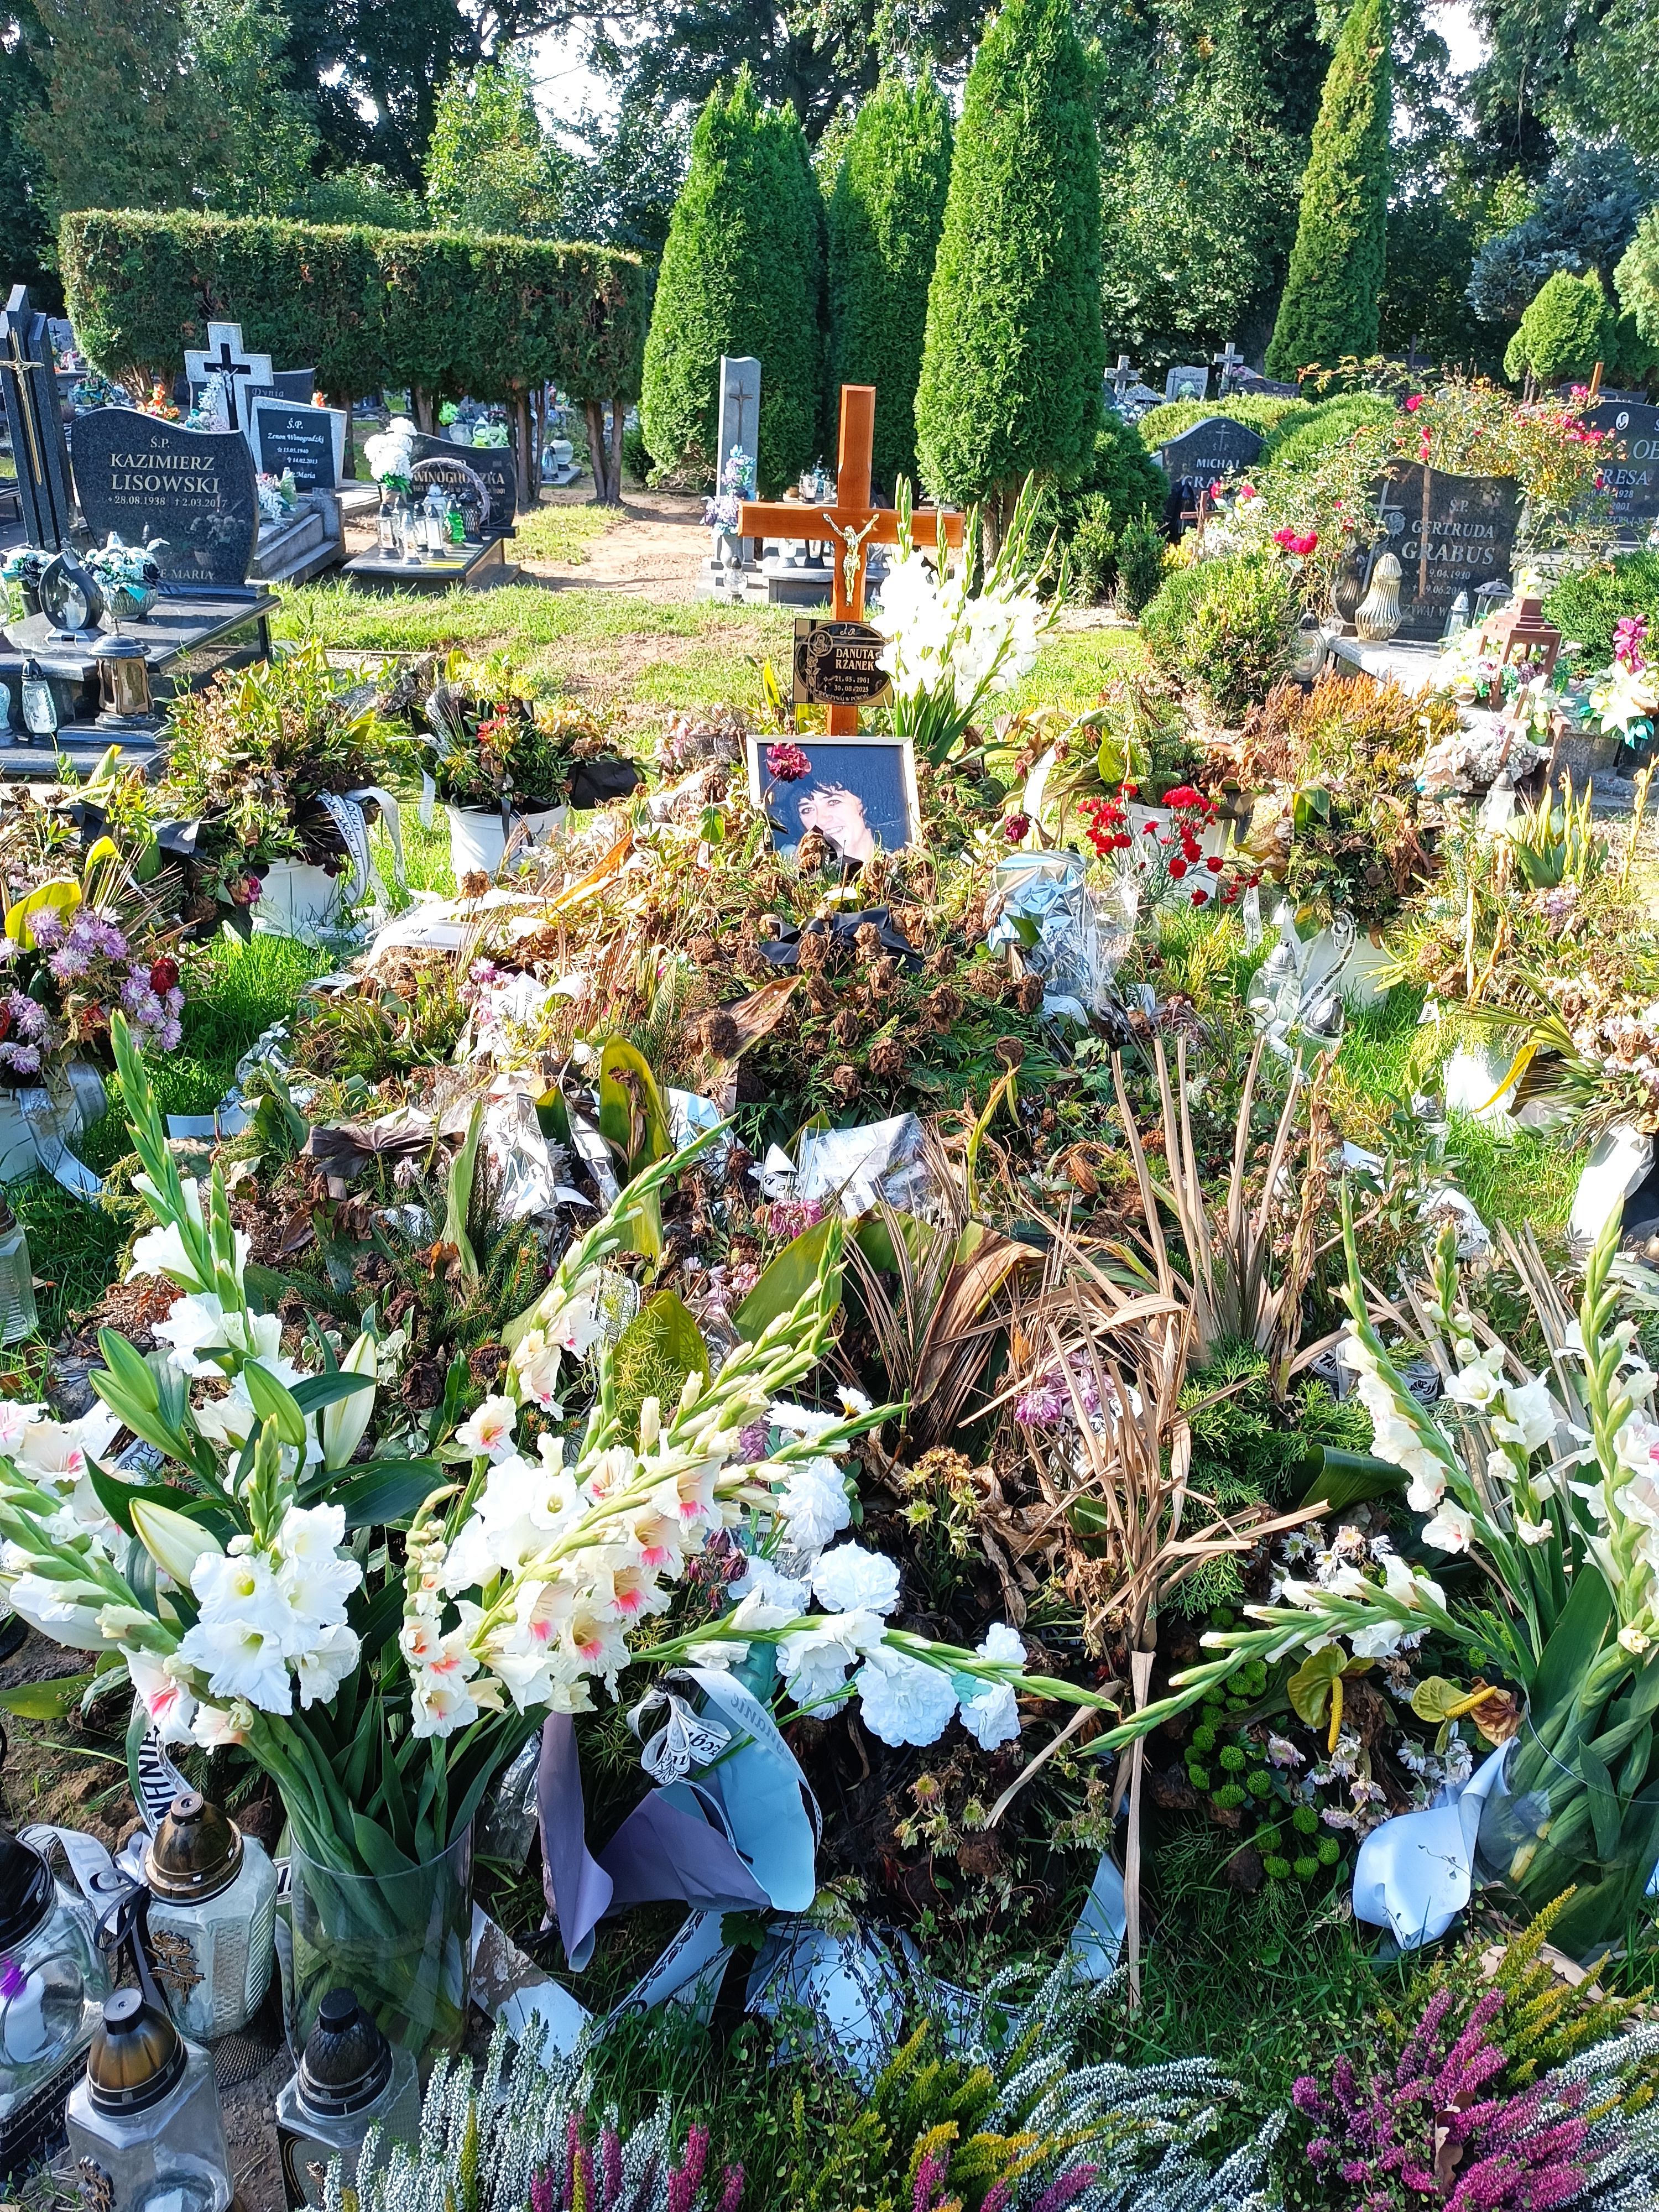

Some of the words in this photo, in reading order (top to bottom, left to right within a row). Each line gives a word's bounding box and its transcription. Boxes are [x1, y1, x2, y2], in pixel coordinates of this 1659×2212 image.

[150, 436, 170, 448] Ś.P.
[111, 453, 215, 471] KAZIMIERZ
[111, 474, 220, 494] LISOWSKI
[1181, 475, 1217, 489] GRA
[114, 495, 166, 506] 28.08.1938
[182, 497, 228, 508] 2.03.2017
[1411, 519, 1494, 539] GERTRUDA
[1401, 541, 1495, 565] GRABUS
[172, 568, 214, 580] MARIA
[1428, 568, 1471, 580] 9.04.1930
[836, 648, 875, 660] DANUTA
[835, 658, 875, 671] RŻANEK
